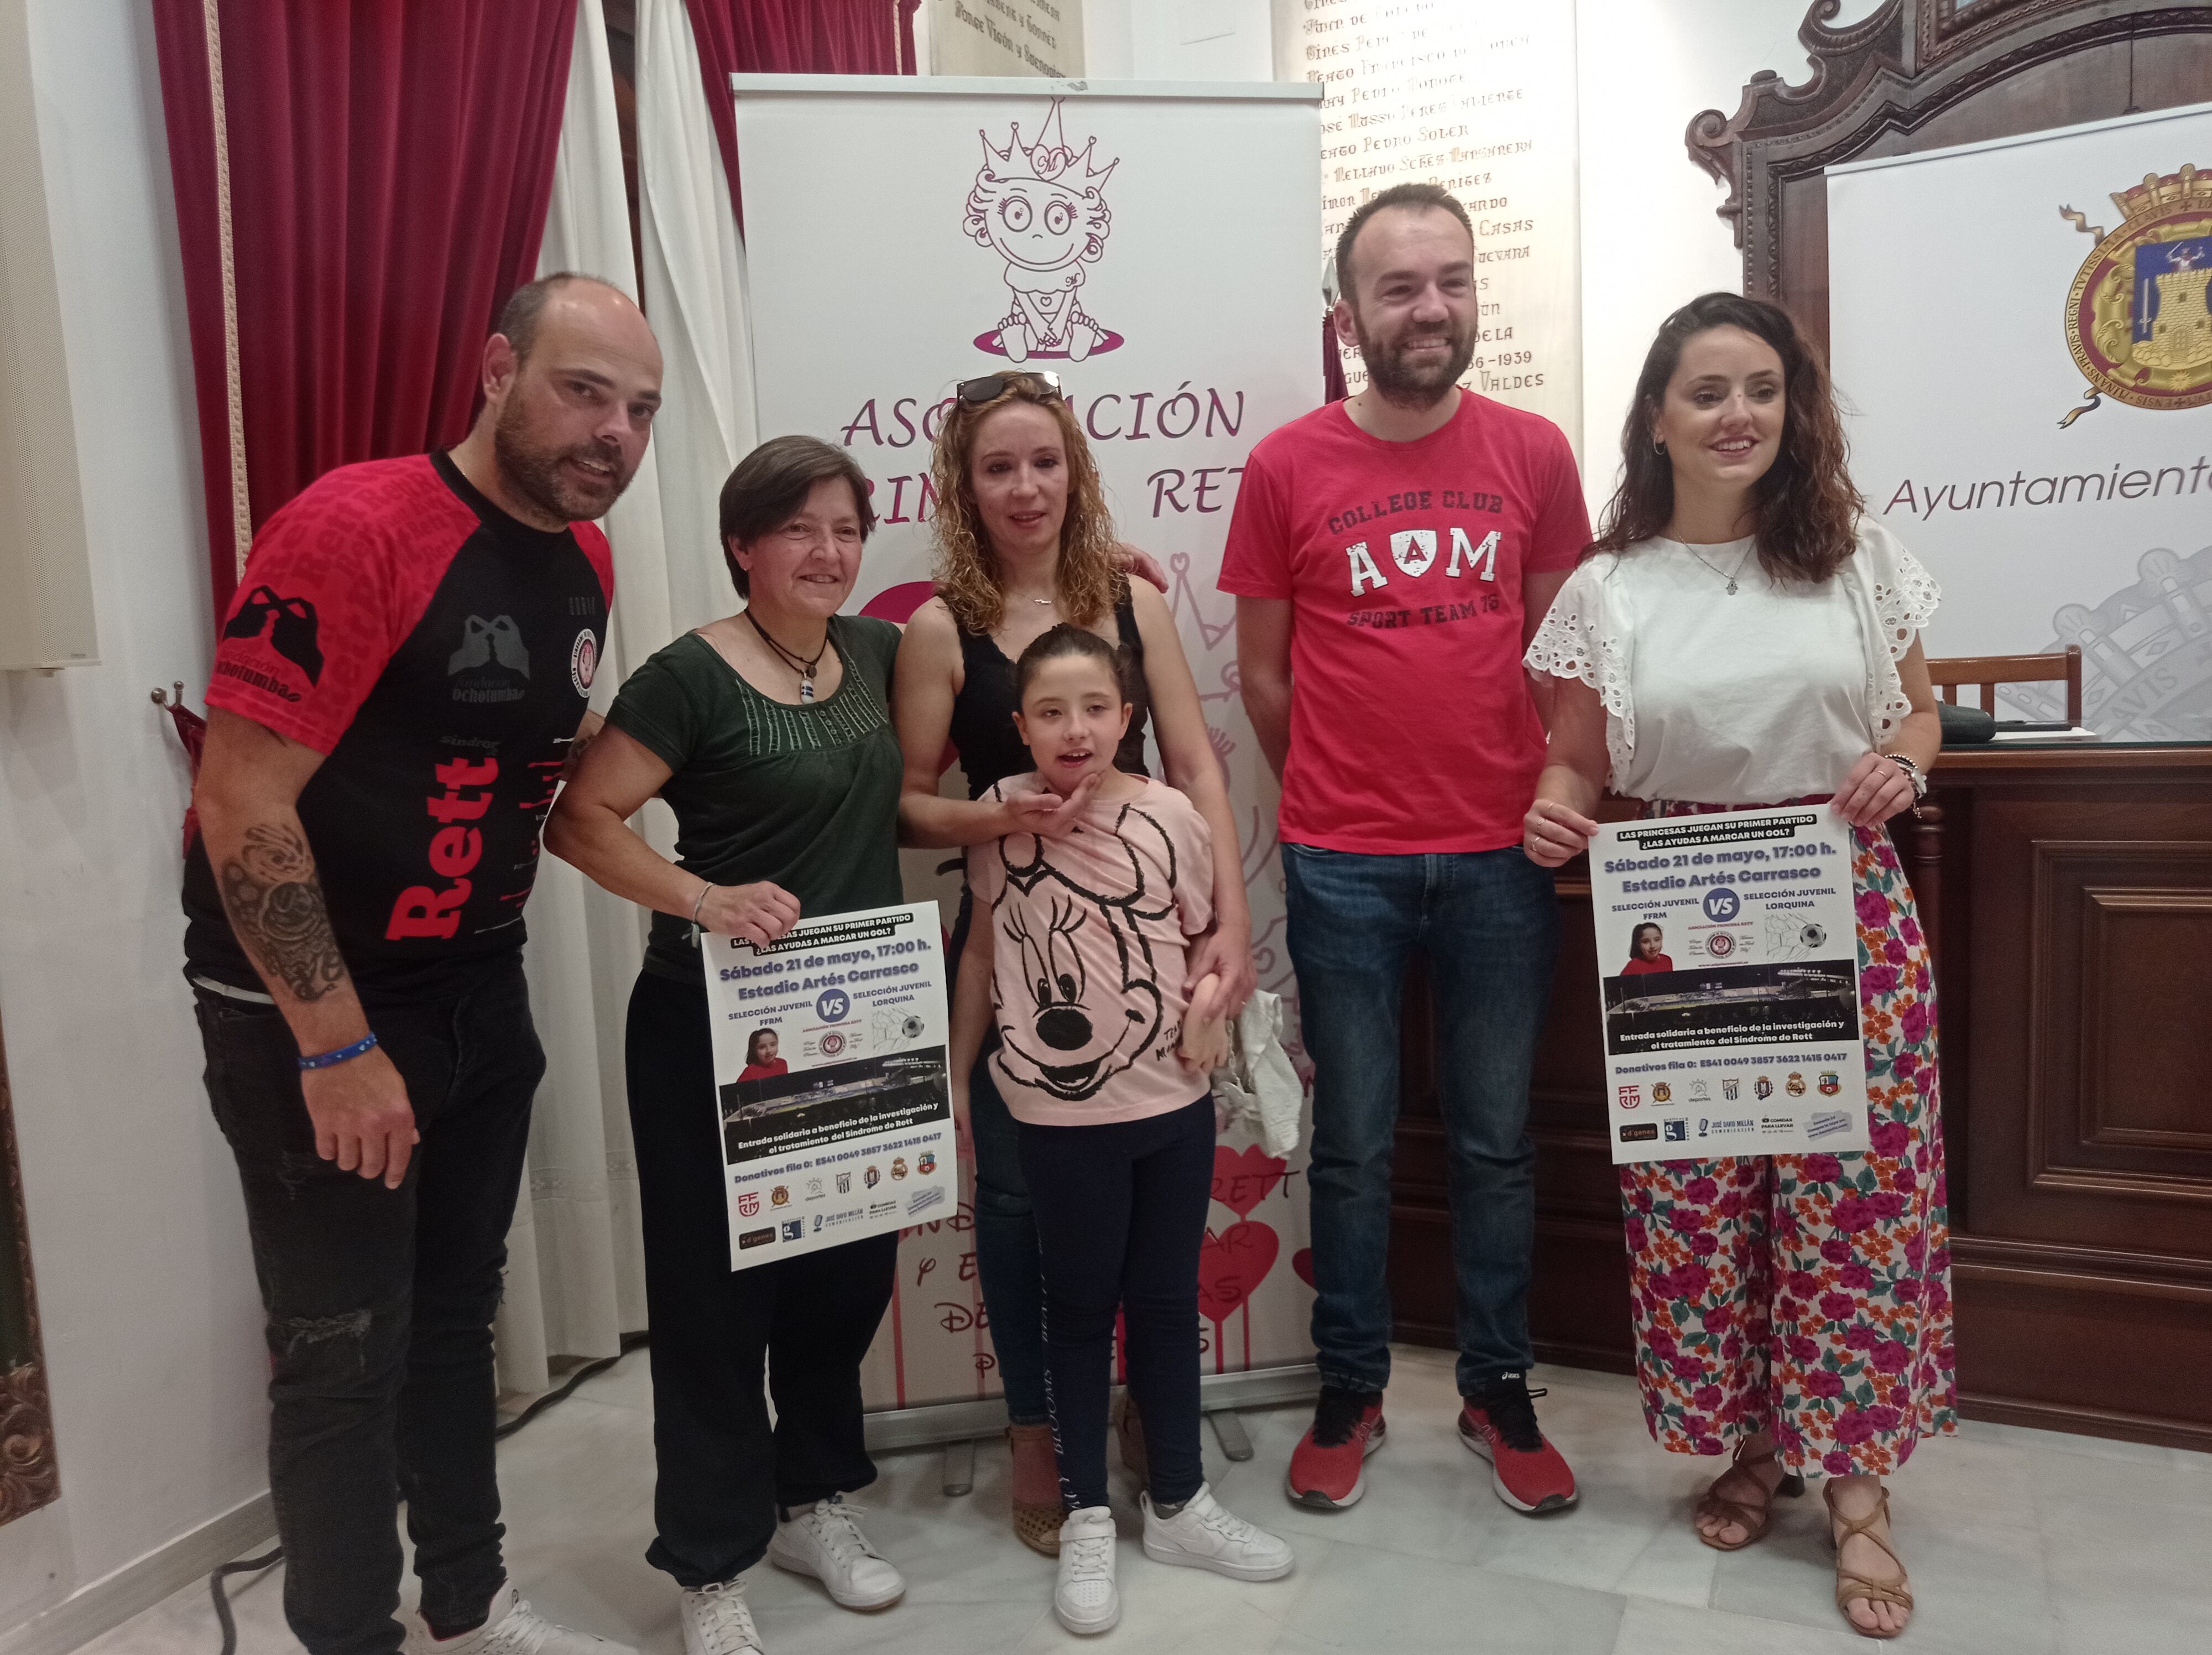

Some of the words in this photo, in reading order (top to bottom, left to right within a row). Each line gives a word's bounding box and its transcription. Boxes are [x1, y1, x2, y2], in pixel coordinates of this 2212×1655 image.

[1479, 220, 1534, 236] CASAS
[2068, 298, 2080, 330] REGNI
[1495, 327, 1514, 341] LA
[2069, 334, 2089, 368] PRAVIS
[1480, 370, 1545, 391] VALDES
[2087, 368, 2130, 400] MINANS
[1328, 490, 1433, 535] COLLEGE
[1442, 490, 1504, 514] CLUB
[1345, 541, 1390, 597] A
[1444, 527, 1502, 582] M
[1345, 610, 1411, 629] SPORT
[1421, 600, 1477, 625] TEAM
[1620, 831, 1636, 840] LAS
[1637, 826, 1686, 838] PRINCESAS
[1687, 823, 1723, 833] JUEGAN
[1738, 819, 1771, 828] PRIMER
[1773, 815, 1814, 825] PARTIDO
[1642, 840, 1663, 850] ¿LAS
[1665, 836, 1701, 846] AYUDAS
[1710, 831, 1750, 841] MARCAR
[1766, 829, 1790, 837] GOL?
[384, 757, 499, 941] Rett
[1604, 856, 1670, 873] Sábado
[1673, 855, 1688, 866] 21
[1691, 852, 1713, 865] de
[1717, 850, 1770, 863] mayo,
[1772, 844, 1817, 858] 17:00
[1820, 842, 1837, 855] h.
[1623, 876, 1686, 893] Estadio
[1688, 871, 1735, 886] Artés
[1738, 867, 1821, 882] Carrasco
[1611, 900, 1661, 912] SELECCIÓN
[1662, 898, 1699, 907] JUVENIL
[1708, 897, 1733, 915] VS
[1765, 901, 1815, 910] LORQUINA
[1743, 889, 1796, 901] SELECCIÓN
[1797, 888, 1836, 896] JUVENIL
[799, 925, 832, 936] JUEGAN
[833, 924, 844, 932] SU
[845, 919, 875, 930] PRIMER
[875, 914, 911, 925] PARTIDO
[1643, 912, 1667, 920] FFRM
[778, 939, 813, 951] AYUDAS
[821, 933, 857, 945] MARCAR
[870, 928, 891, 938] GOL?
[720, 961, 784, 981] Sábado
[786, 958, 801, 971] 21
[804, 955, 825, 968] de
[827, 949, 875, 965] mayo,
[877, 940, 915, 957] 17:00
[917, 939, 931, 951] h.
[738, 980, 800, 1000] Estadio
[802, 972, 846, 991] Artés
[848, 963, 919, 982] Carrasco
[853, 986, 898, 999] SELECCIÓN
[899, 981, 932, 992] JUVENIL
[728, 1006, 776, 1020] SELECCIÓN
[778, 1001, 813, 1012] JUVENIL
[821, 998, 844, 1016] VS
[872, 995, 915, 1007] LORQUINA
[759, 1016, 783, 1027] FFRM
[1620, 1032, 1656, 1042] Entrada
[1656, 1028, 1696, 1038] solidaria
[1704, 1024, 1747, 1034] beneficio
[1772, 1020, 1835, 1031] investigación
[1836, 1021, 1845, 1029] y
[1660, 1039, 1715, 1049] tratamiento
[1792, 1032, 1813, 1040] Rett
[1615, 1064, 1666, 1075] Donativos
[1668, 1061, 1686, 1070] fila
[1700, 1059, 1722, 1068] ES41
[1724, 1057, 1749, 1066] 0049
[1750, 1056, 1775, 1064] 3857
[1777, 1055, 1800, 1063] 3622
[1824, 1053, 1848, 1061] 0417
[738, 1137, 773, 1149] Entrada
[774, 1128, 811, 1142] solidaria
[818, 1118, 858, 1132] beneficio
[879, 1103, 933, 1120] investigación
[778, 1137, 829, 1152] tratamiento
[831, 1132, 844, 1141] del
[884, 1121, 895, 1130] de
[895, 1118, 913, 1127] Rett
[1736, 1118, 1754, 1127] MILLÁN
[734, 1167, 785, 1183] Donativos
[786, 1163, 802, 1172] fila
[816, 1155, 836, 1166] ES41
[837, 1151, 860, 1161] 0049
[860, 1145, 881, 1156] 3857
[883, 1141, 903, 1152] 3622
[904, 1136, 921, 1147] 1415
[922, 1132, 942, 1143] 0417
